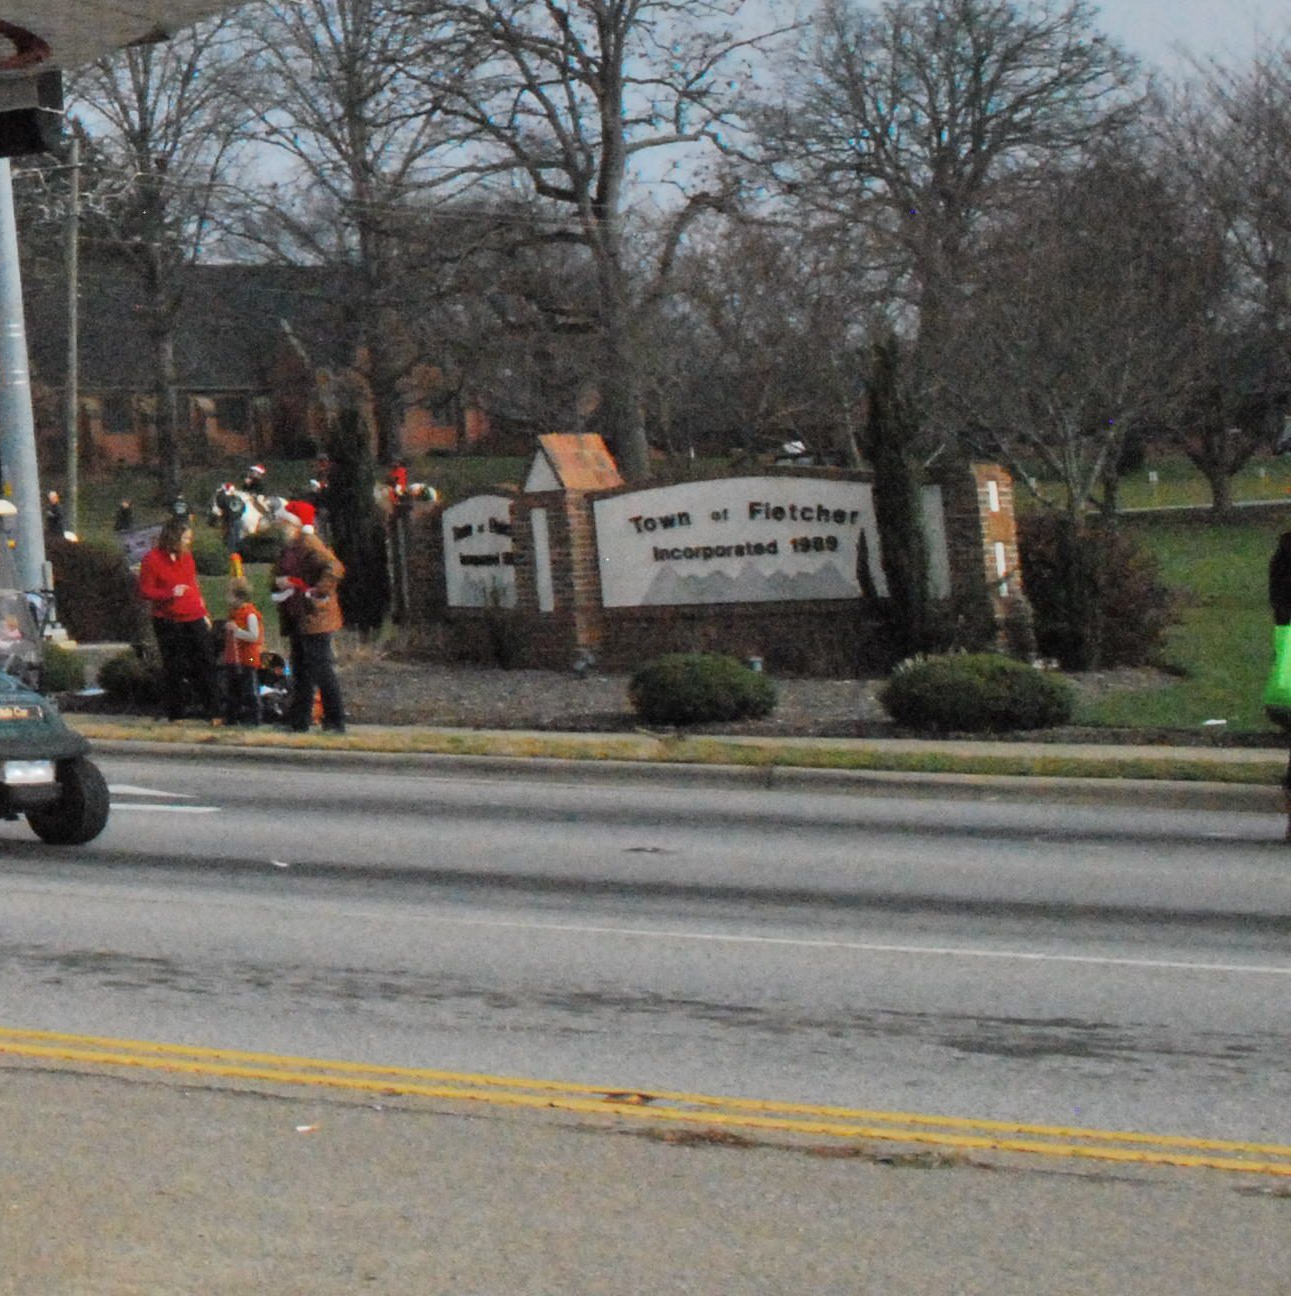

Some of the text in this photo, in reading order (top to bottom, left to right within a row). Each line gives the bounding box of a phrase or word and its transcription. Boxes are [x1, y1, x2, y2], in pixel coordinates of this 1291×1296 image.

[629, 501, 860, 534] Town of Fletcher
[652, 539, 779, 562] Incorporated
